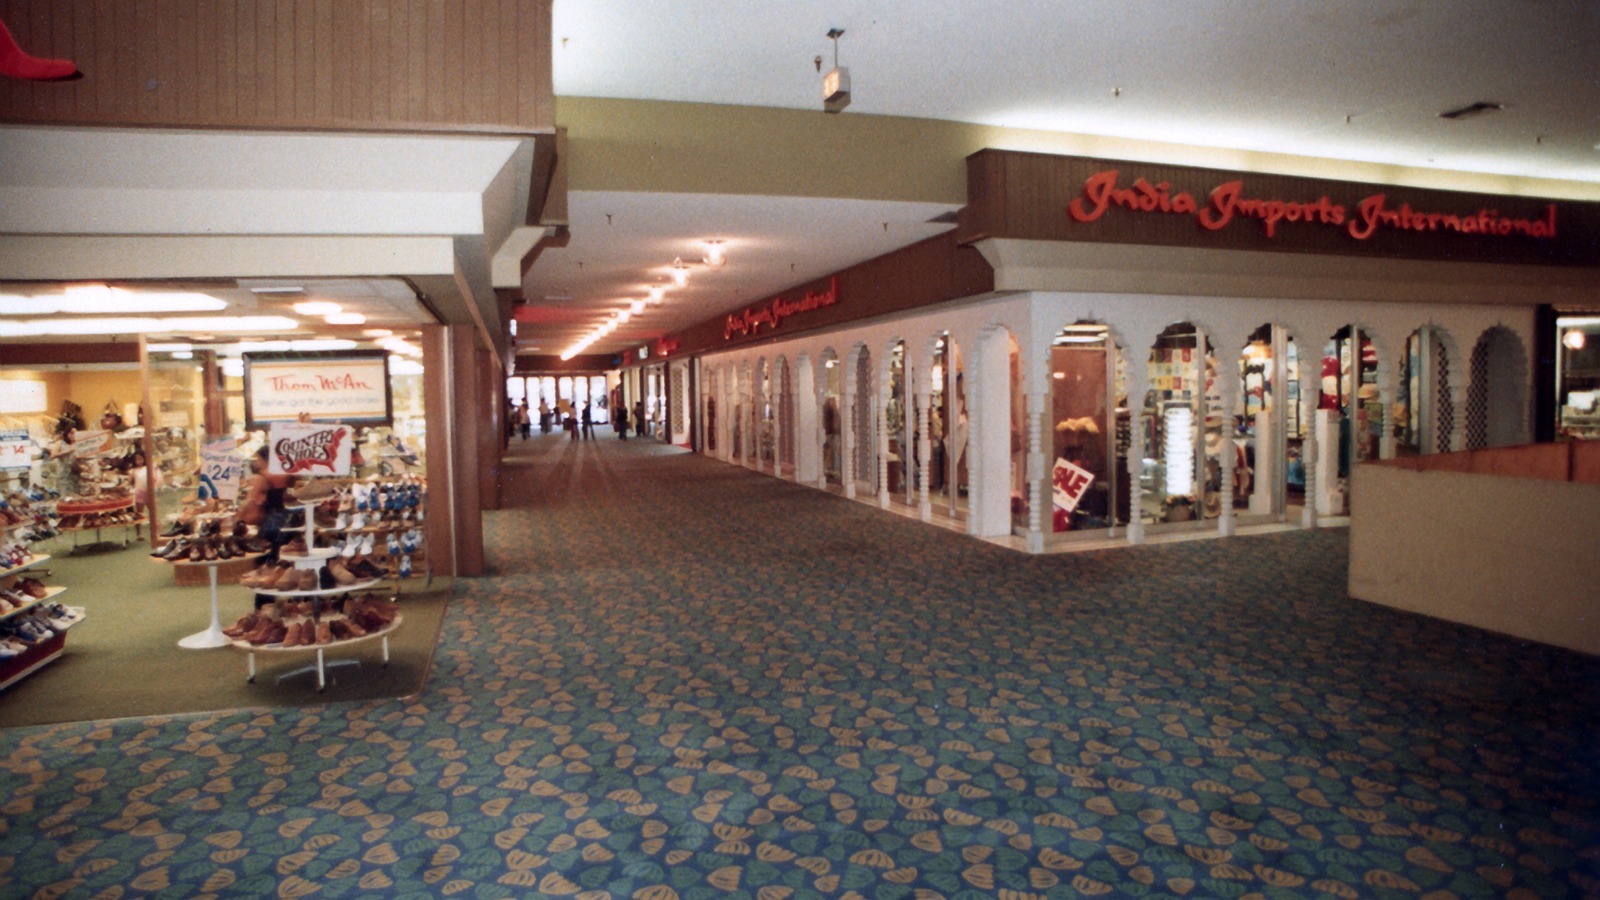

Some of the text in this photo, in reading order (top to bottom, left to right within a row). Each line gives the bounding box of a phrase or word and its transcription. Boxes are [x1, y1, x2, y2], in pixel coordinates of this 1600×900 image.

[1069, 169, 1557, 240] India Imports International
[770, 275, 837, 328] International
[267, 373, 373, 392] Thom McAn
[275, 430, 334, 455] COUNTRY
[282, 445, 330, 471] SHOES
[1053, 466, 1090, 499] SALE
